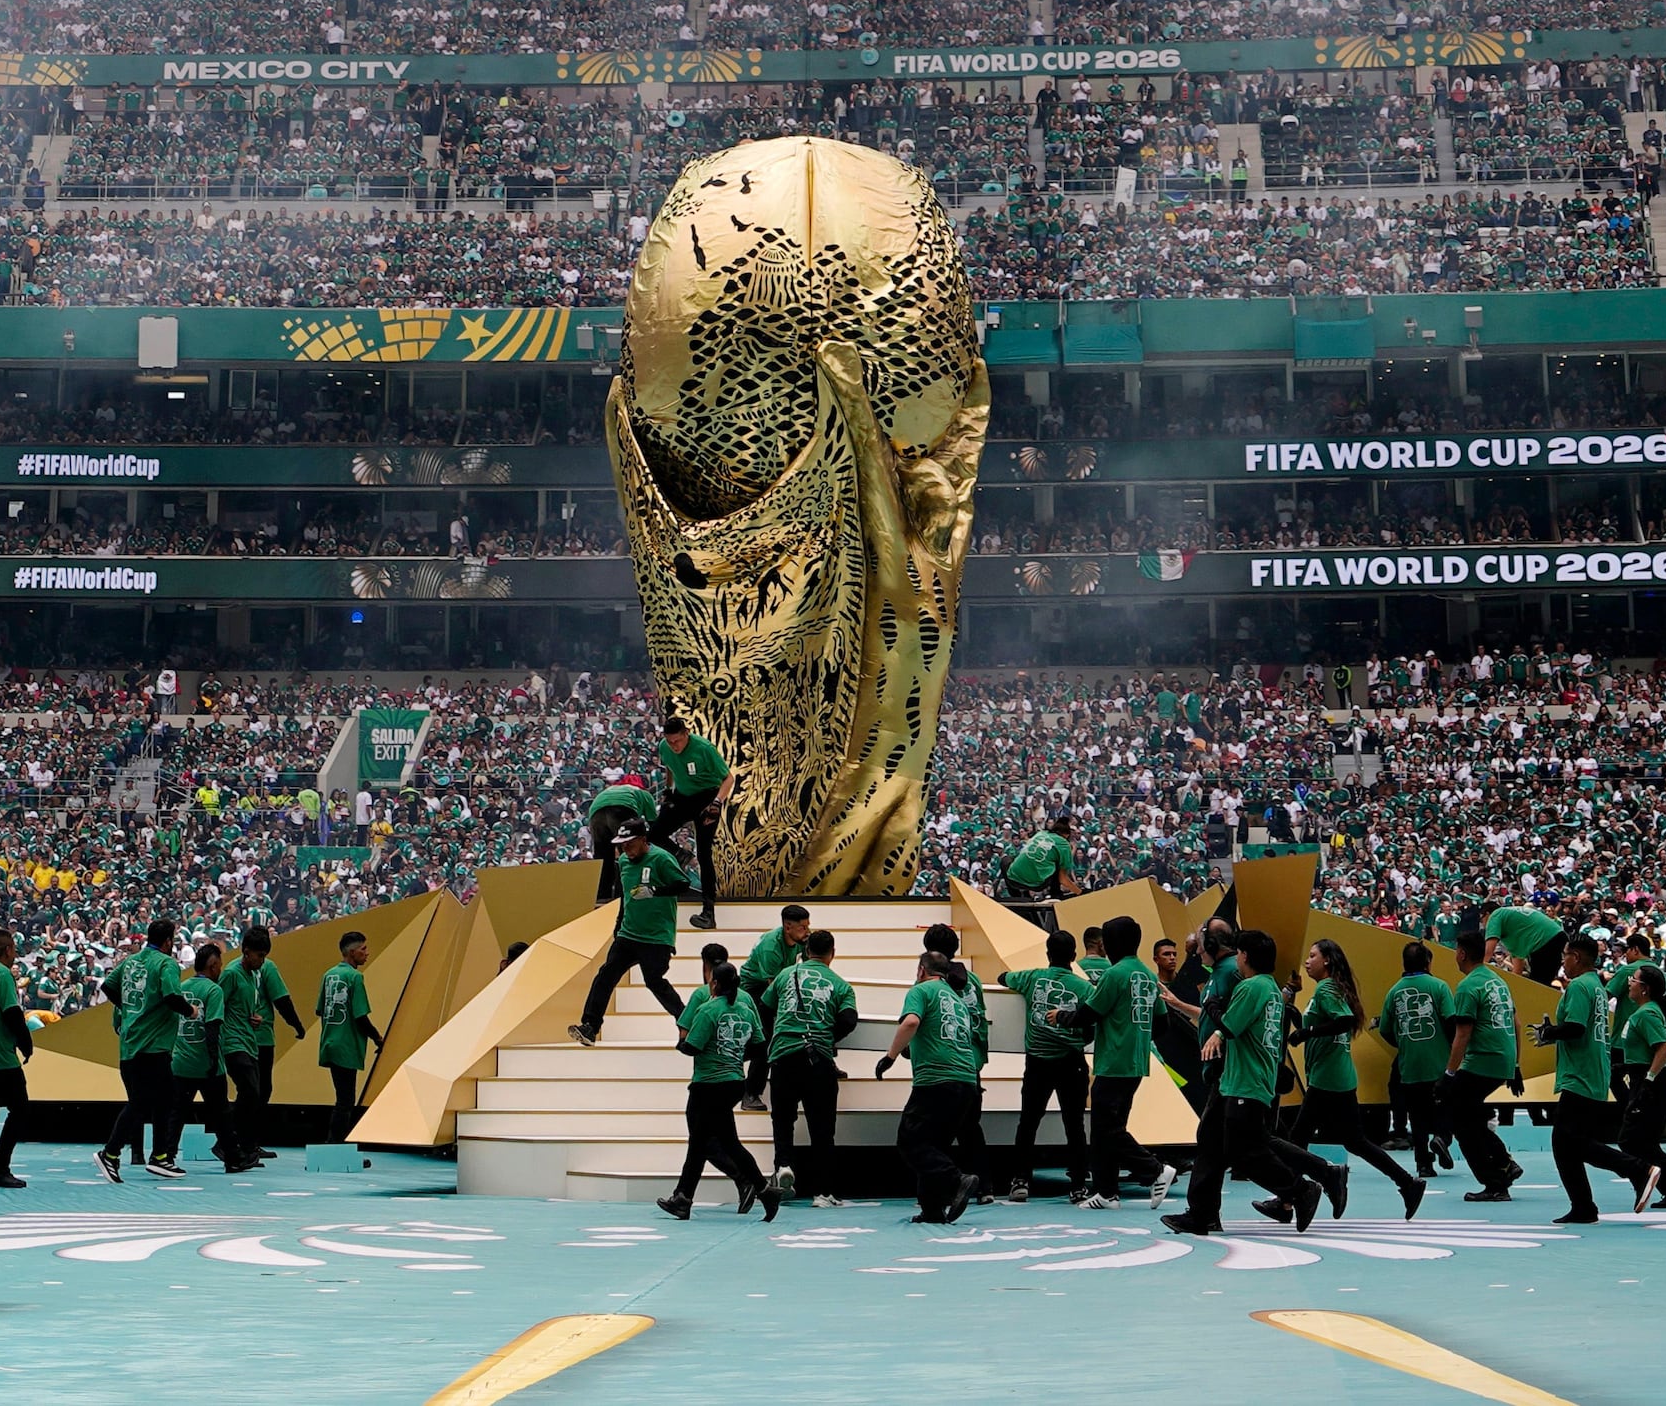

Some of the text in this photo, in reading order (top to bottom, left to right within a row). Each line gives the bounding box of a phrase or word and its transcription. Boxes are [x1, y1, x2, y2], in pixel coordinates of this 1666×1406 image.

[163, 60, 410, 80] MEXICO CITY
[894, 49, 1181, 74] FIFA WORLD CUP 2026
[16, 454, 161, 480] #FIFAWorldCup
[1245, 443, 1323, 471] FIFA
[1327, 440, 1462, 470] WORLD
[1468, 438, 1541, 467] CUP
[14, 568, 158, 593] #FIFAWorldCup
[1250, 557, 1330, 586] FIFA
[1334, 555, 1469, 585] WORLD
[1475, 554, 1549, 583] CUP
[371, 728, 414, 744] SALIDA
[375, 745, 401, 761] EXIT
